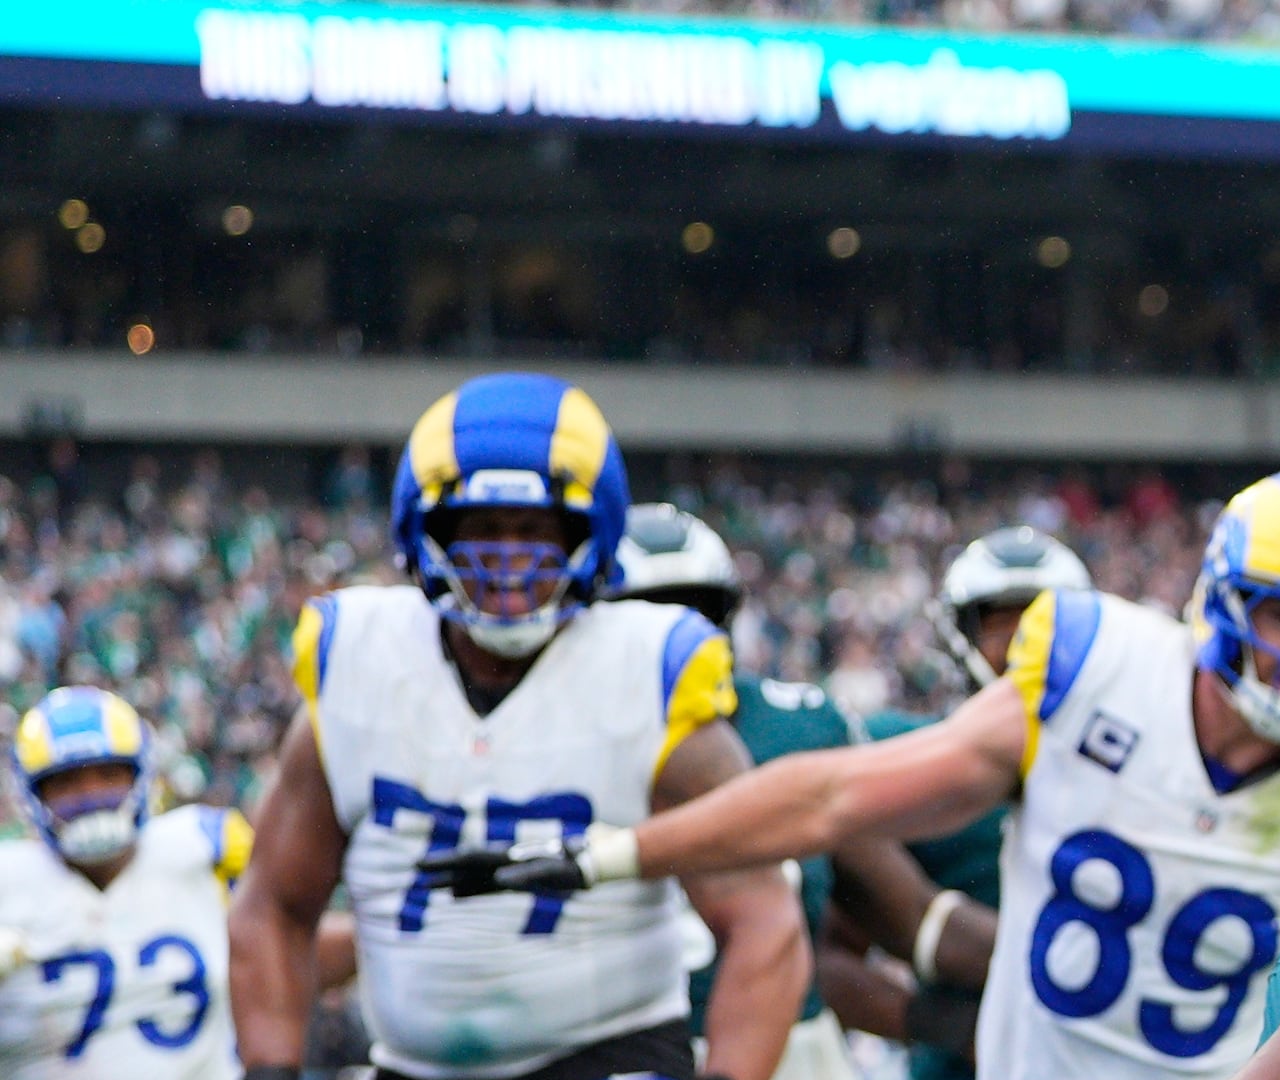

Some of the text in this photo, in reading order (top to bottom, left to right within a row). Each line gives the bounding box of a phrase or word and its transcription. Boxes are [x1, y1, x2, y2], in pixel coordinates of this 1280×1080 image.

[371, 774, 594, 935] 77
[36, 933, 210, 1060] 73
[1029, 827, 1280, 1058] 89
